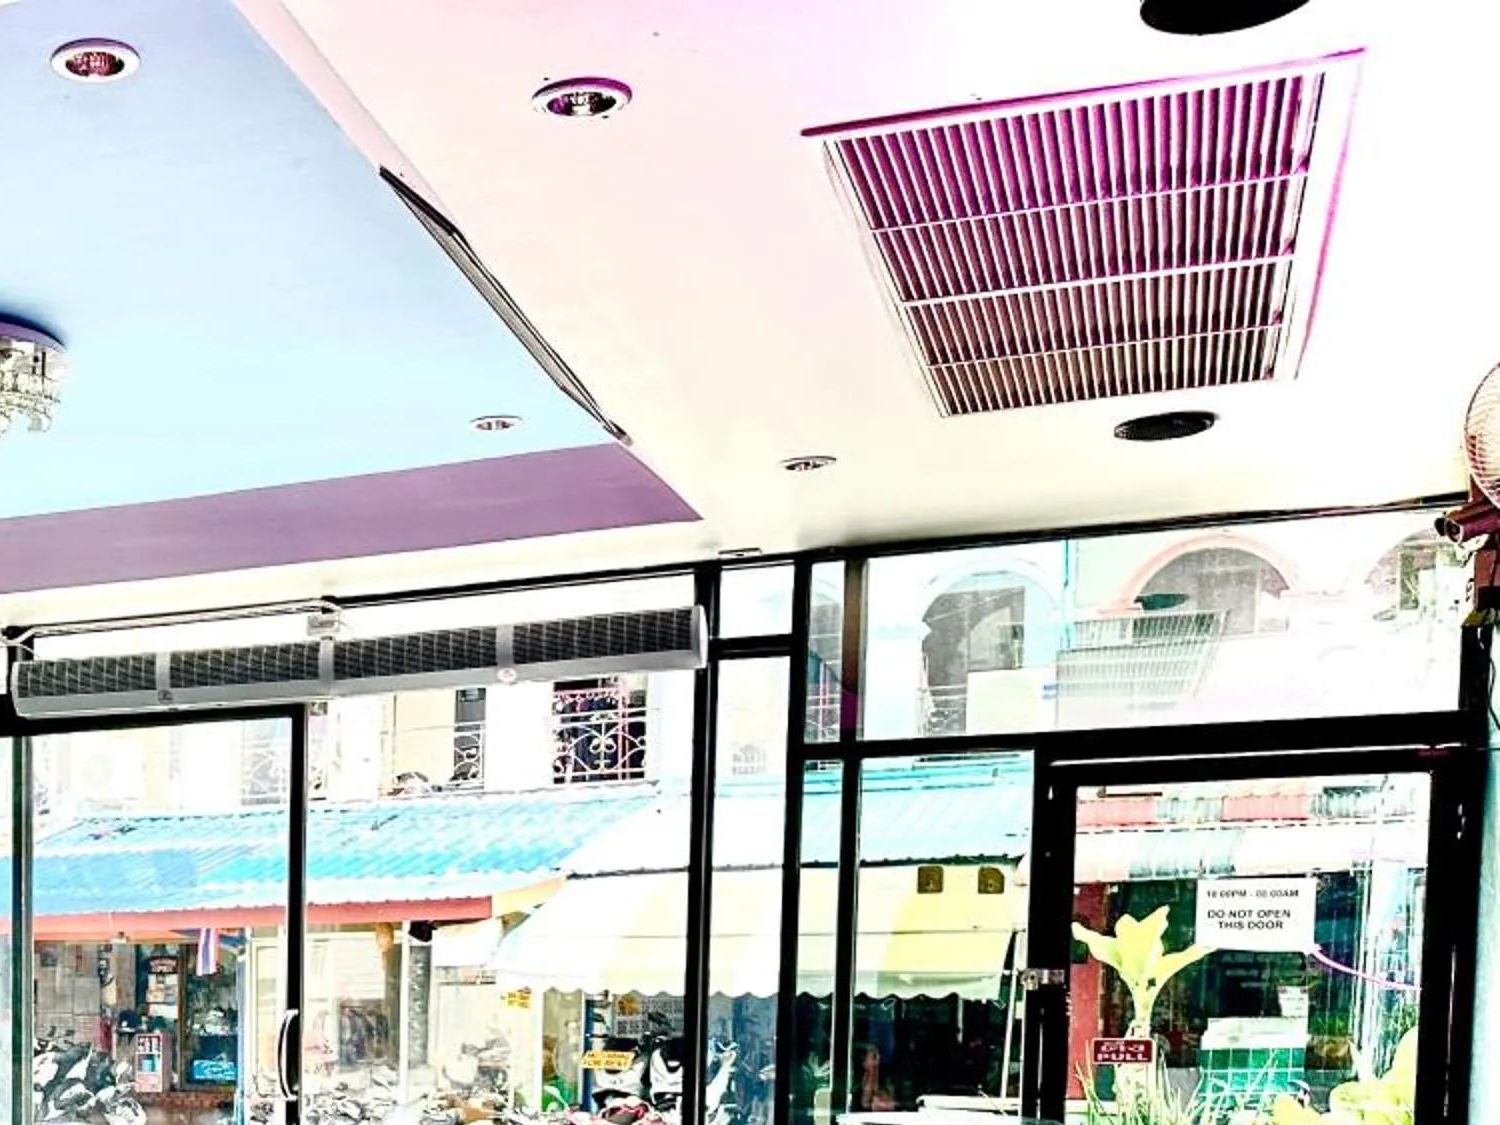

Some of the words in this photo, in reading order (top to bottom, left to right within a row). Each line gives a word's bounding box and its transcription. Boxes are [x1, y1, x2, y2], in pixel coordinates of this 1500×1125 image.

[1207, 909, 1226, 919] DO
[1228, 909, 1253, 919] NOT
[1257, 908, 1291, 919] OPEN
[1219, 920, 1245, 930] THIS
[1247, 920, 1284, 930] DOOR
[1097, 1053, 1149, 1061] PULL
